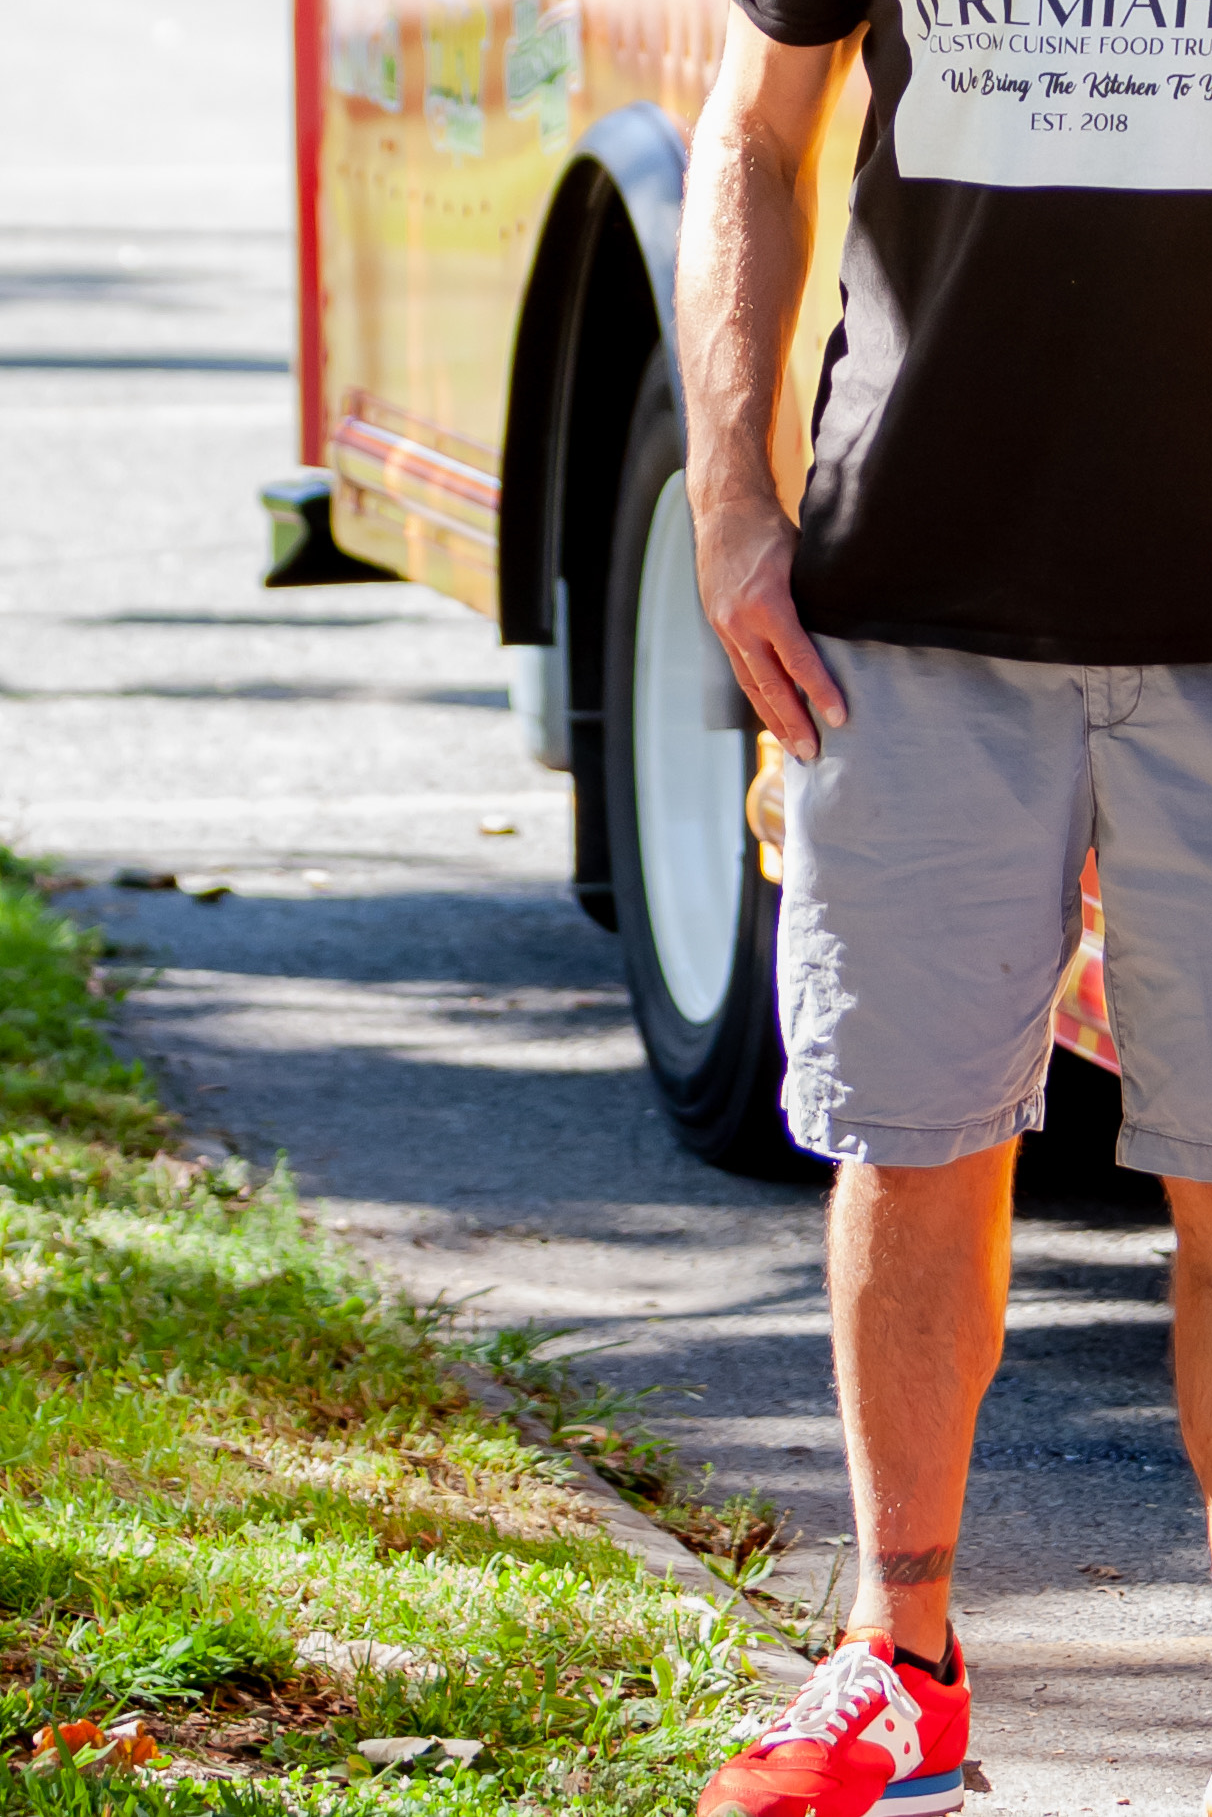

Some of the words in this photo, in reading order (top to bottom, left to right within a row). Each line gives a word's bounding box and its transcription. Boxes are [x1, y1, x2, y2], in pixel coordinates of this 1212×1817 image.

[929, 32, 1004, 54] CUSTOM
[1009, 34, 1092, 55] CUISINE
[1100, 36, 1164, 55] FOOD
[941, 67, 979, 94] We
[981, 69, 1033, 102] Bring
[1038, 71, 1077, 99] The
[1083, 71, 1160, 99] Kitchen
[1166, 73, 1197, 100] To
[1031, 113, 1073, 132] EST.
[1080, 113, 1129, 132] 2018
